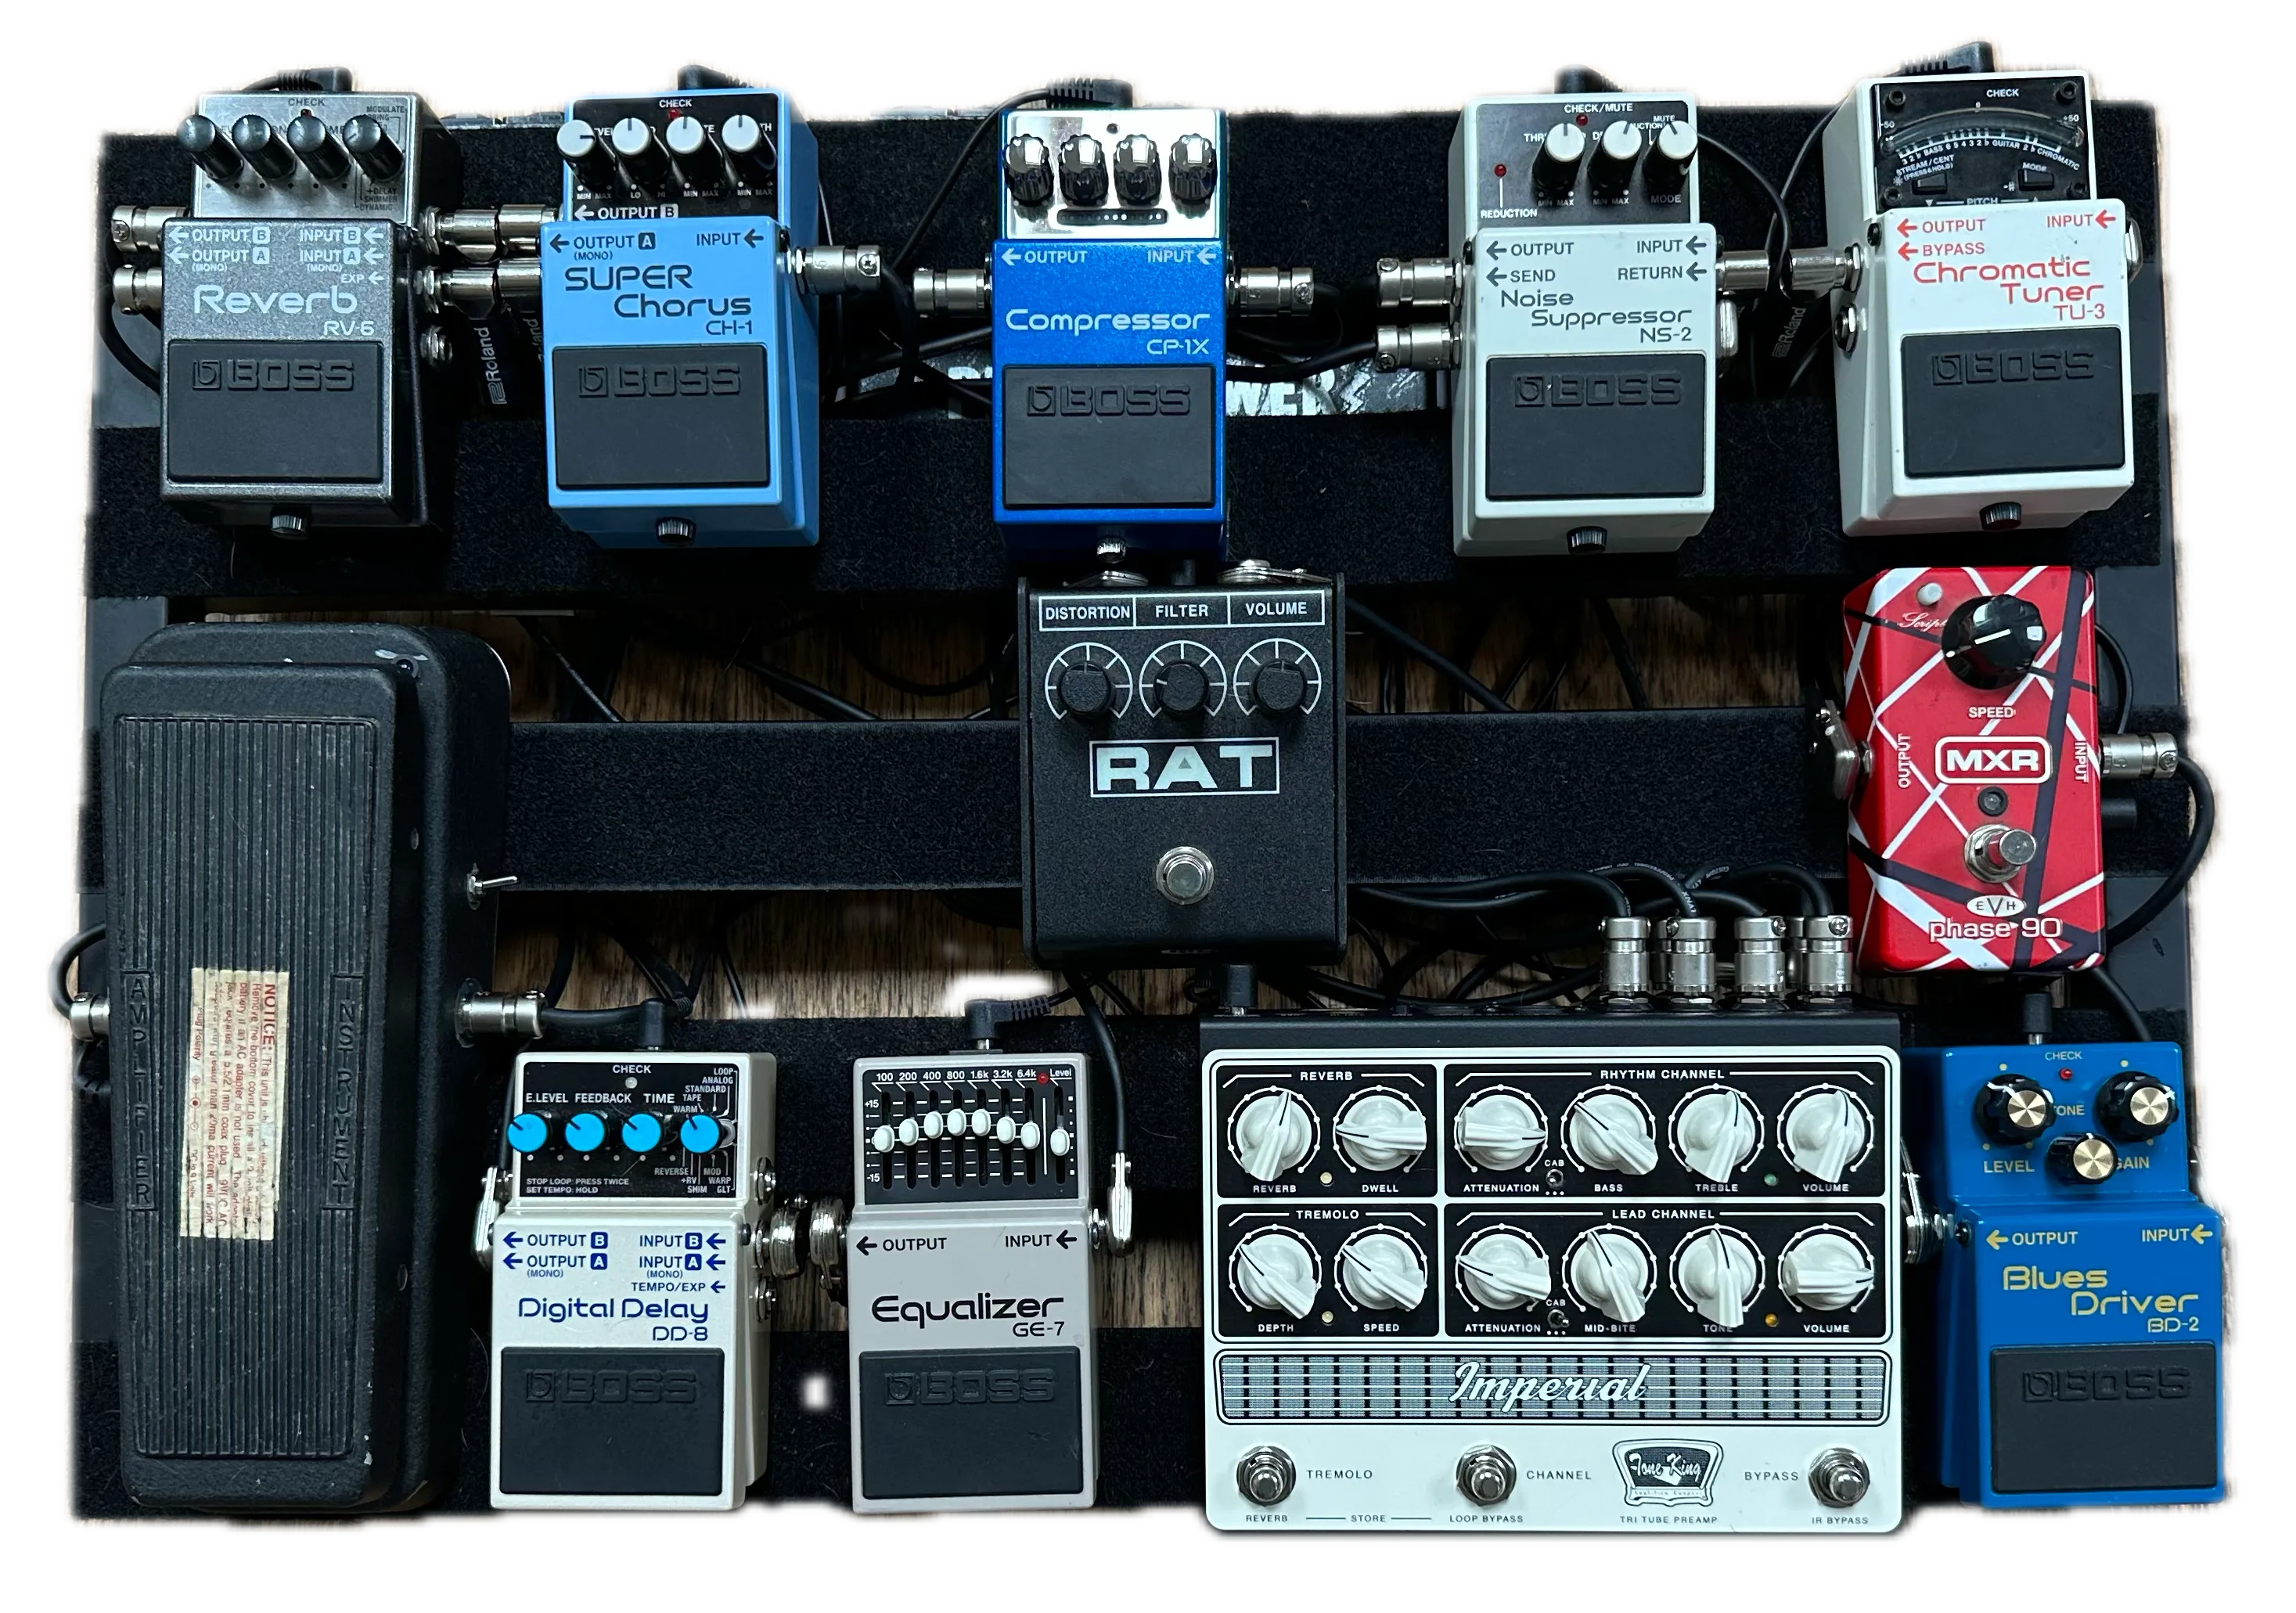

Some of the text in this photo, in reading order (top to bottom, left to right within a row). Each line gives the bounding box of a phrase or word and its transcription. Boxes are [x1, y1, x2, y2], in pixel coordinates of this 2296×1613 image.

[1986, 88, 2019, 98] CHECK
[288, 98, 325, 106] CHECK
[659, 99, 692, 108] CHECK
[1564, 103, 1633, 113] CHECK/MUTE
[1924, 140, 2080, 171] BASS GUITAR CHROMATIC
[1895, 154, 1955, 176] STREAM/CENT
[1650, 195, 1682, 203] MODE
[1966, 197, 1999, 206] PITCH
[597, 207, 657, 219] OUTPUT
[1481, 209, 1538, 218] REDUCTION
[1922, 219, 1986, 232] OUTPUT
[2046, 214, 2093, 228] INPUT
[193, 229, 249, 242] OUTPUT
[300, 230, 341, 242] INPUT
[696, 232, 741, 246] INPUT
[574, 236, 635, 250] OUTPUT
[1510, 242, 1574, 257] OUTPUT
[1637, 239, 1683, 254] INPUT
[1923, 243, 1985, 257] BYPASS
[193, 250, 249, 262] OUTPUT
[300, 250, 341, 262] INPUT
[574, 251, 614, 261] (MONO)
[1024, 250, 1088, 264] OUTPUT
[1147, 250, 1194, 263] INPUT
[192, 263, 228, 272] (MONO)
[1618, 266, 1682, 281] RETURN
[1913, 256, 2090, 284] Chromatic
[341, 274, 365, 283] EXP
[565, 265, 693, 291] SUPER
[1510, 269, 1556, 283] SEND
[194, 285, 358, 314] Reverb
[1501, 290, 1574, 308] Noise
[2000, 283, 2105, 304] Tuner
[614, 293, 751, 318] Chorus
[2053, 304, 2105, 321] TU-3
[1006, 308, 1210, 337] Compressor
[1531, 309, 1692, 330] Suppressor
[324, 321, 374, 336] RV-6
[706, 320, 753, 335] CH-1
[1640, 327, 1692, 343] NS-2
[1146, 338, 1210, 355] CP-1X
[473, 326, 502, 382] Roland
[1965, 349, 2094, 384] BOSS
[227, 359, 354, 391] BOSS
[614, 364, 740, 397] BOSS
[1551, 373, 1681, 407] BOSS
[1060, 384, 1190, 416] BOSS
[1045, 602, 1307, 621] DISTORTION FILTER VOLUME
[1968, 707, 2013, 718] SPEED
[1096, 745, 1272, 790] RAT
[1898, 734, 1911, 788] OUTPUT
[1947, 749, 2039, 772] MXR
[2074, 741, 2089, 783] INPUT
[1975, 898, 2016, 916] EVH
[1929, 917, 2061, 942] phase 90
[262, 985, 276, 1050] NOTICE:
[2045, 1051, 2082, 1060] CHECK
[613, 1065, 651, 1074] CHECK
[876, 1068, 1071, 1082] 100 200 400 800 1.6k 3.2k 6.4k Level
[1300, 1071, 1352, 1081] REVERB
[1600, 1070, 1725, 1079] RHYTHM CHANNEL
[131, 979, 153, 1203] AMPLIFIER
[329, 981, 354, 1203] INSTRUMENT
[526, 1093, 675, 1104] E.LEVEL FEEDBACK TIME
[865, 1100, 879, 1108] +15
[1984, 1159, 2035, 1174] LEVEL
[867, 1174, 880, 1183] -15
[1695, 1183, 1849, 1192] TREBLE VOLUME
[1296, 1210, 1359, 1220] TREMOLO
[1612, 1210, 1715, 1219] LEAD CHANNEL
[527, 1234, 587, 1248] OUTPUT
[639, 1235, 683, 1248] INPUT
[1005, 1234, 1053, 1248] INPUT
[2012, 1231, 2078, 1245] OUTPUT
[2142, 1228, 2190, 1242] INPUT
[883, 1237, 947, 1251] OUTPUT
[527, 1255, 587, 1268] OUTPUT
[639, 1256, 683, 1269] INPUT
[527, 1269, 564, 1279] (MONO)
[646, 1269, 683, 1280] (MONO)
[2003, 1266, 2107, 1291] Blues
[632, 1282, 706, 1293] TEMPO/EXP
[2071, 1290, 2198, 1316] Driver
[519, 1298, 708, 1323] Digital Delay
[872, 1292, 1063, 1329] Equalizer
[1013, 1322, 1064, 1337] GE-7
[2147, 1316, 2199, 1333] BD-2
[652, 1327, 708, 1341] DD-8
[561, 1370, 697, 1403] BOSS
[920, 1370, 1054, 1405] BOSS
[1448, 1361, 1651, 1413] Imperial
[2057, 1368, 2190, 1401] BOSS
[1308, 1470, 1373, 1479] TREMOLO
[1628, 1453, 1703, 1482] Tone King
[1527, 1471, 1591, 1480] CHANNEL
[1744, 1471, 1799, 1481] BYPASS
[1449, 1514, 1524, 1523] LOOP BYPASS
